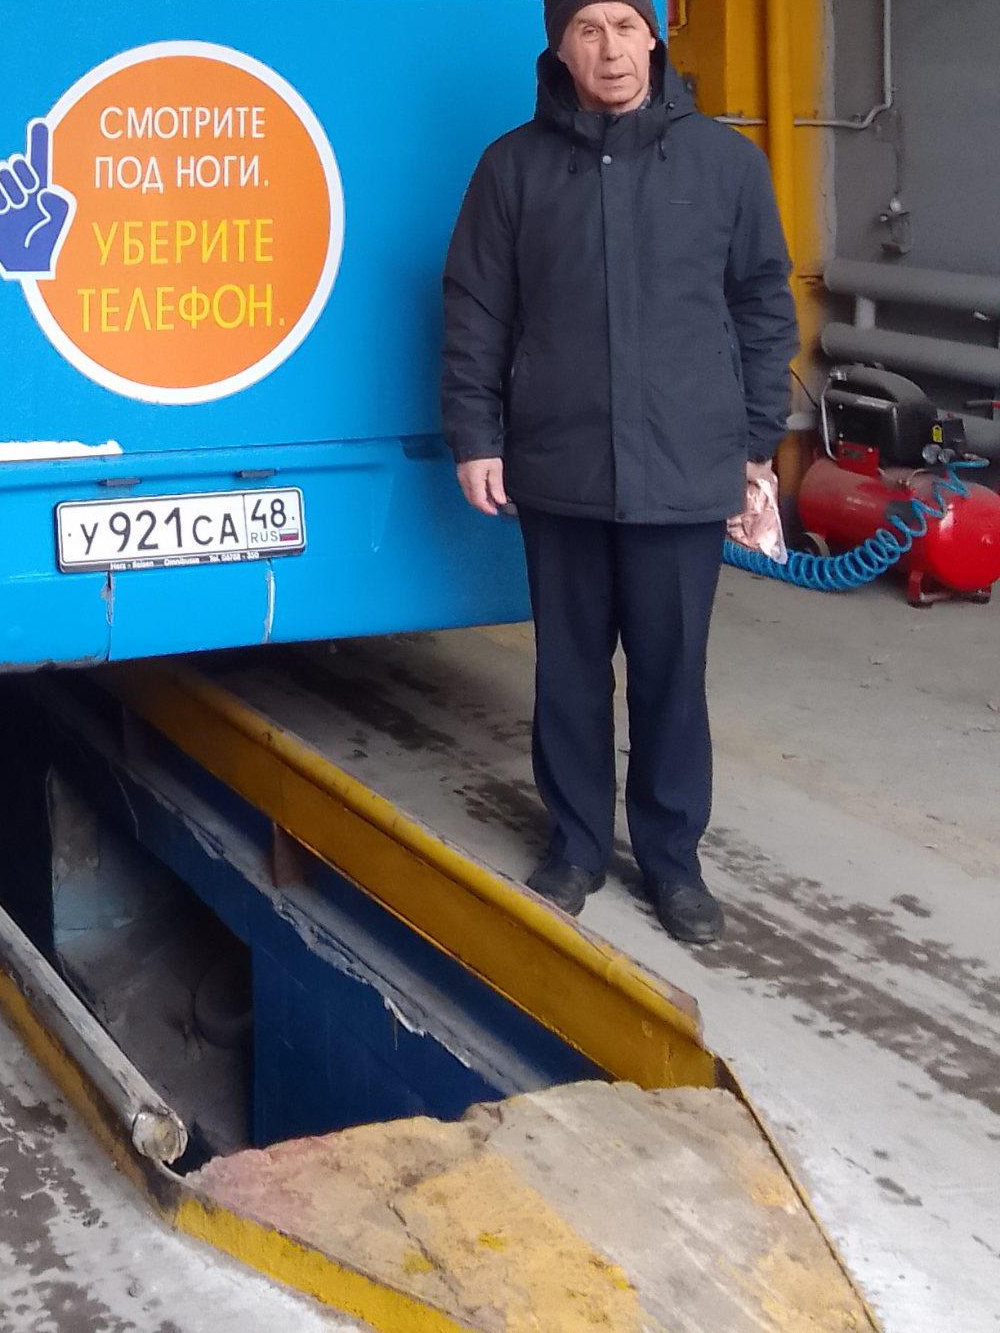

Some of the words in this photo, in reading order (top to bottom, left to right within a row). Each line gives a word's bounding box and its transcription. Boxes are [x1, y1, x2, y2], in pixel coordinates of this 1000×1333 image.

[100, 106, 266, 140] СМОТРИТЕ
[94, 156, 164, 194] ПОД
[176, 155, 270, 188] НОГИ.
[91, 218, 274, 267] УБЕРИТЕ
[77, 283, 286, 333] ТЕЛЕФОН.
[250, 498, 287, 529] 48
[250, 530, 278, 544] RUS
